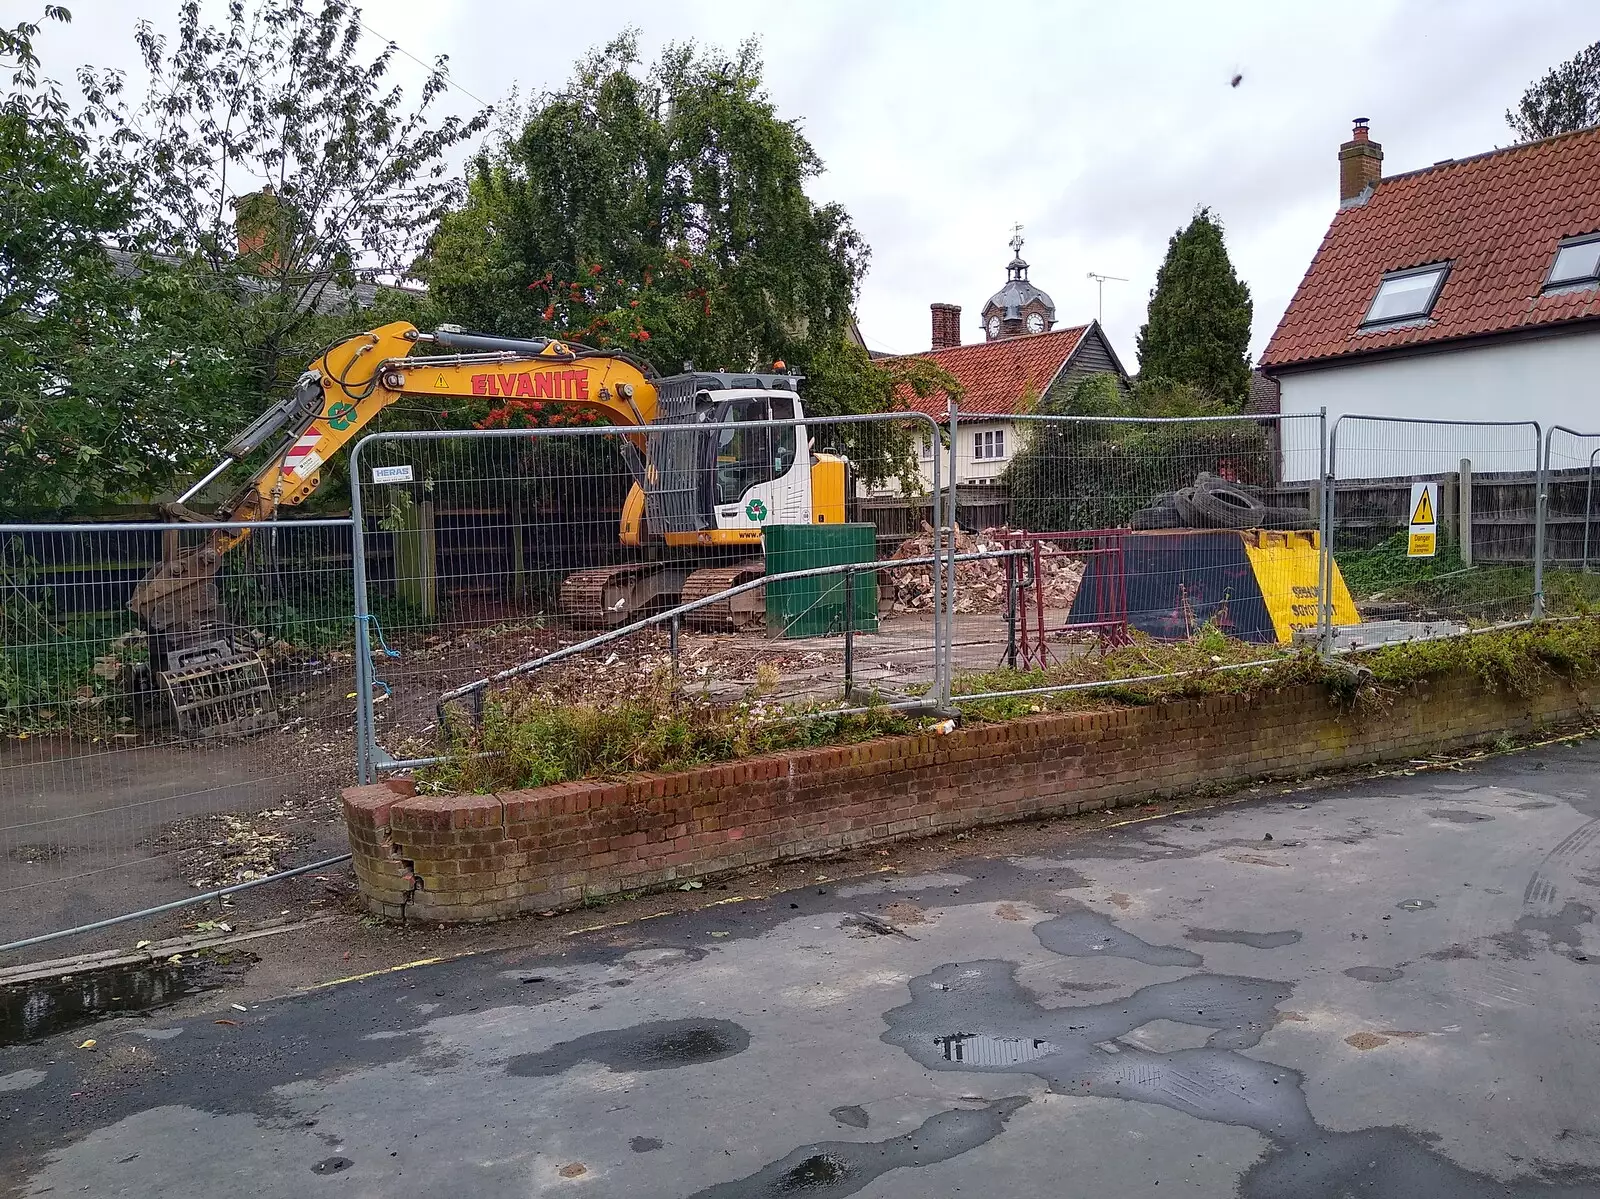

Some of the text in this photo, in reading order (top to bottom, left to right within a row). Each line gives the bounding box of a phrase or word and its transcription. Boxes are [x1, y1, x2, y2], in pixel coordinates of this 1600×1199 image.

[471, 369, 589, 400] ELVANITE
[376, 468, 409, 477] HERAS
[1414, 534, 1431, 543] Danger
